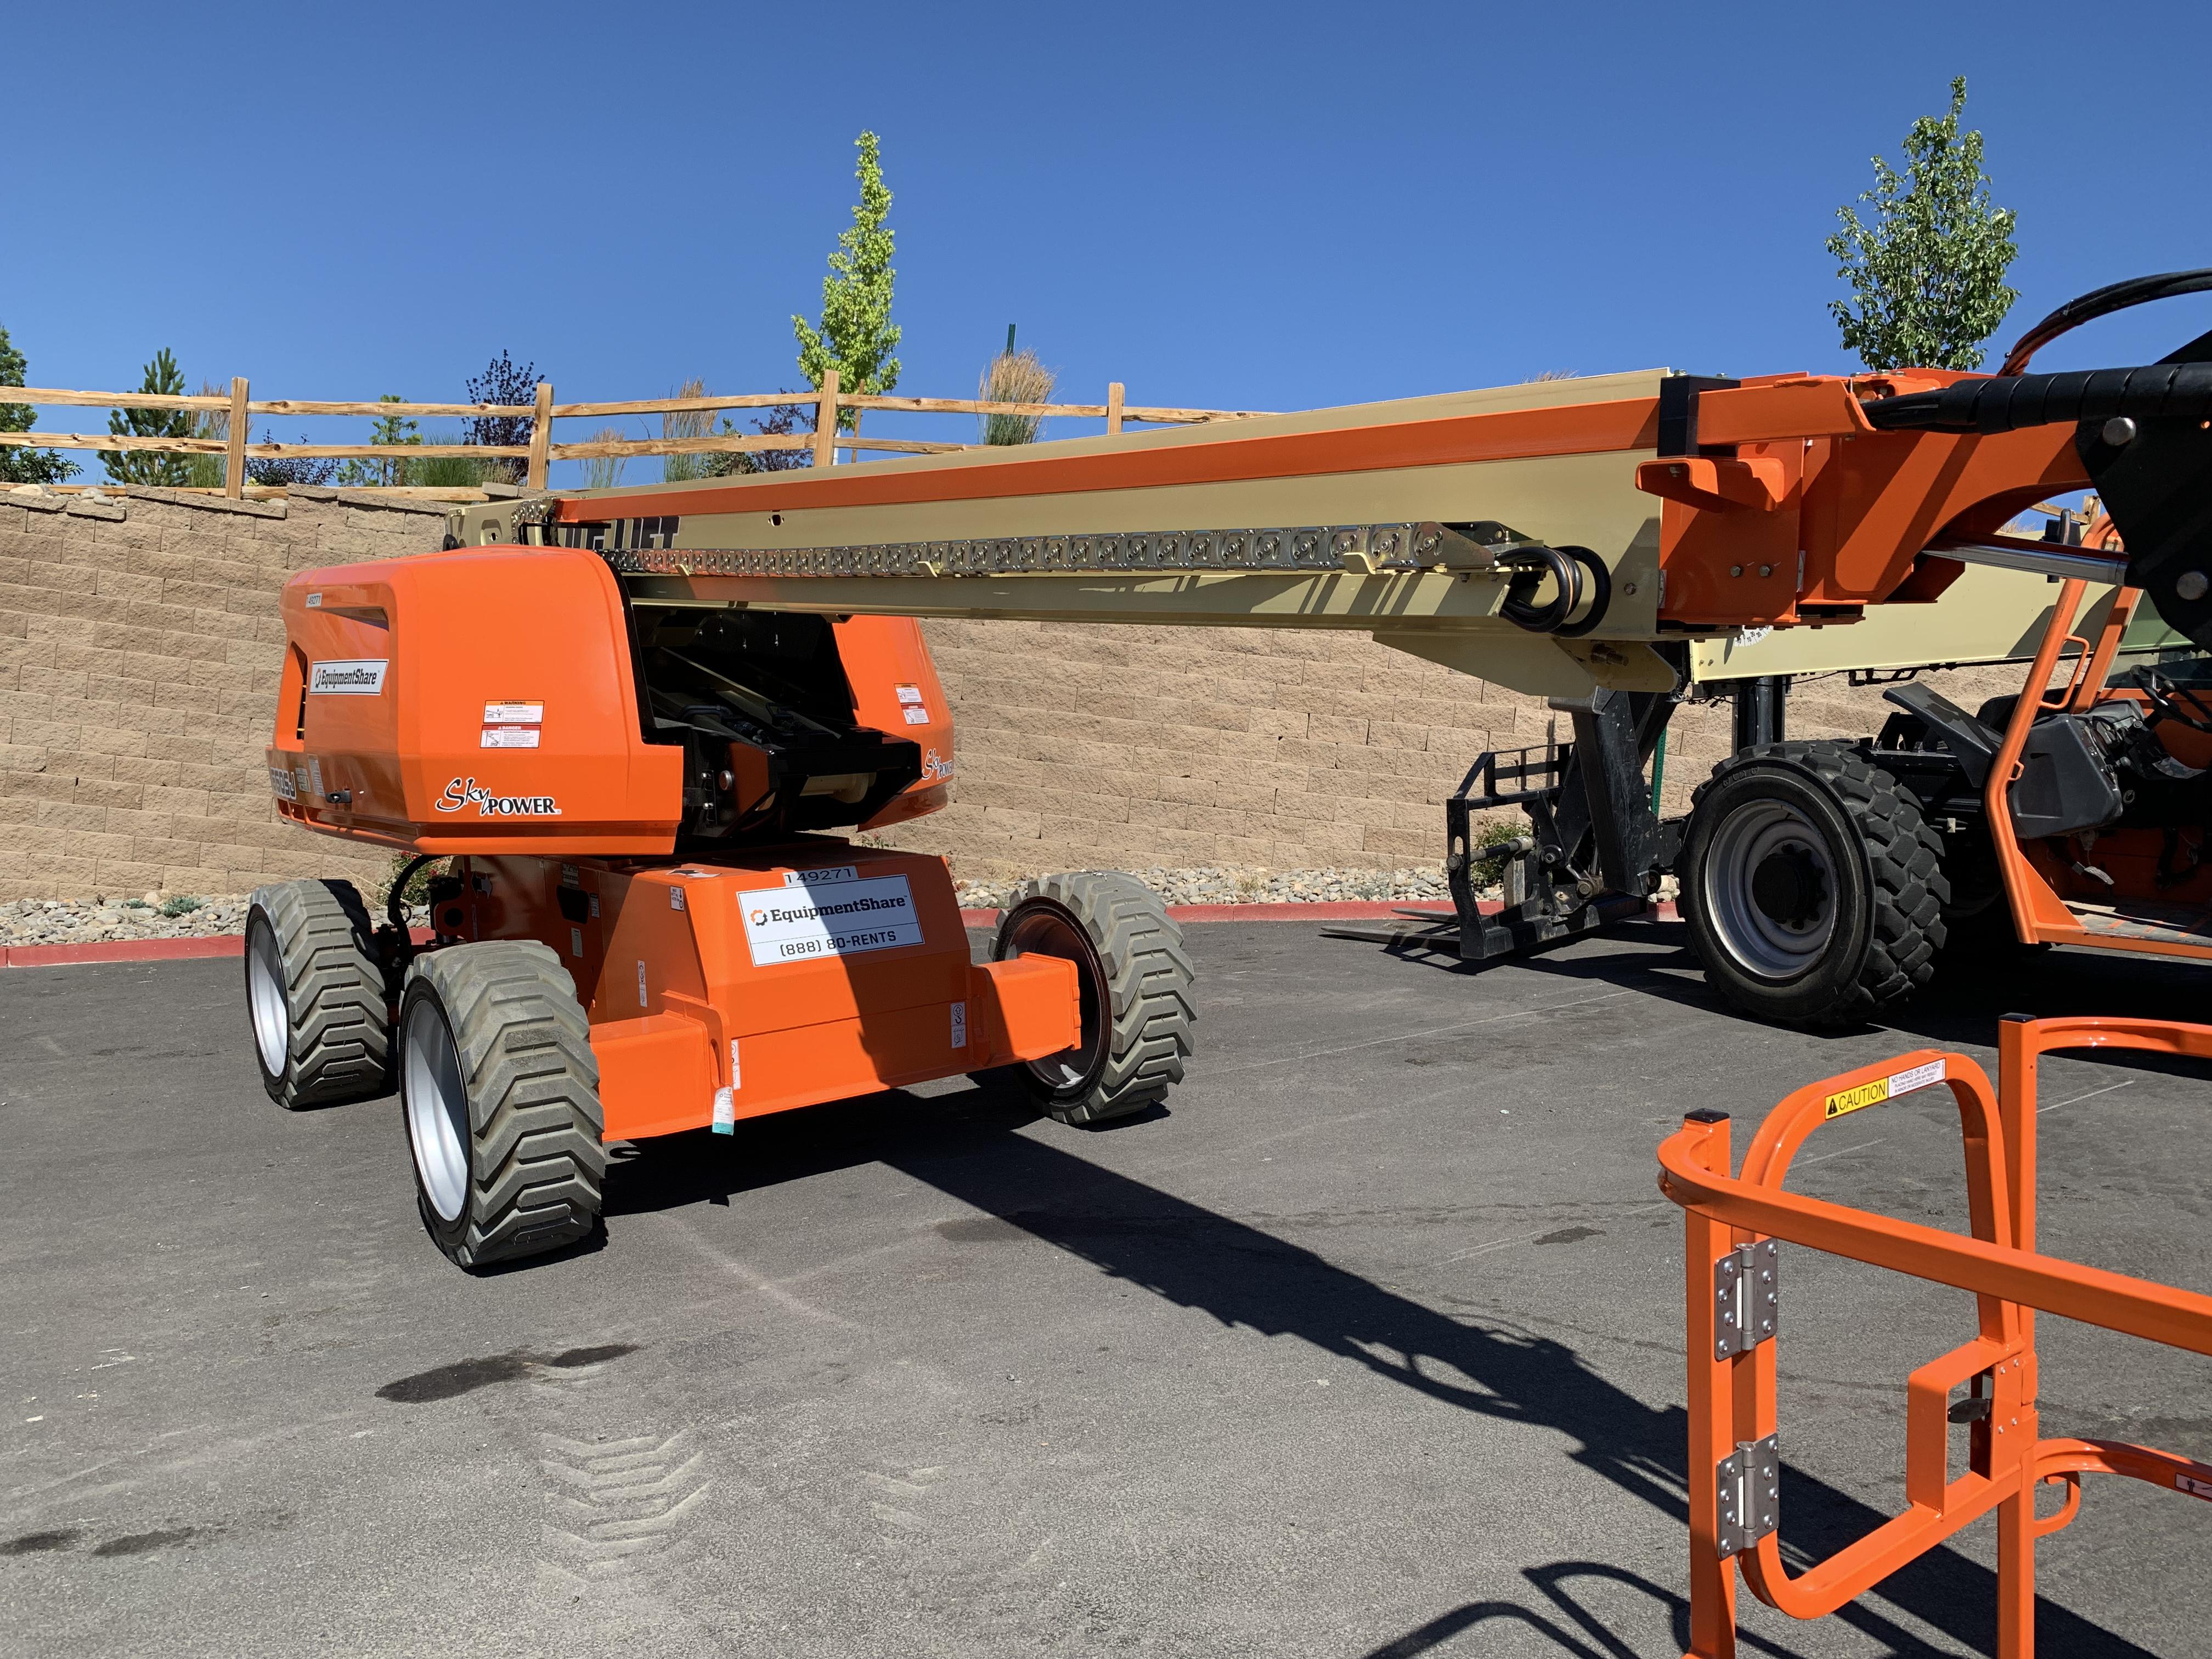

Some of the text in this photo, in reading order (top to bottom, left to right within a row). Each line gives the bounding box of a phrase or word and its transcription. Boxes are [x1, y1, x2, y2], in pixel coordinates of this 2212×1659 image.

[306, 595, 321, 605] 149271
[321, 668, 377, 689] EquipmentShare
[785, 868, 852, 884] 149271
[770, 895, 906, 923] EquipmentShare
[780, 930, 896, 957] (888) 80-RENTS
[1899, 1071, 1914, 1080] HANDS
[1921, 1062, 1940, 1074] LANYARD
[1838, 1082, 1886, 1110] CAUTION
